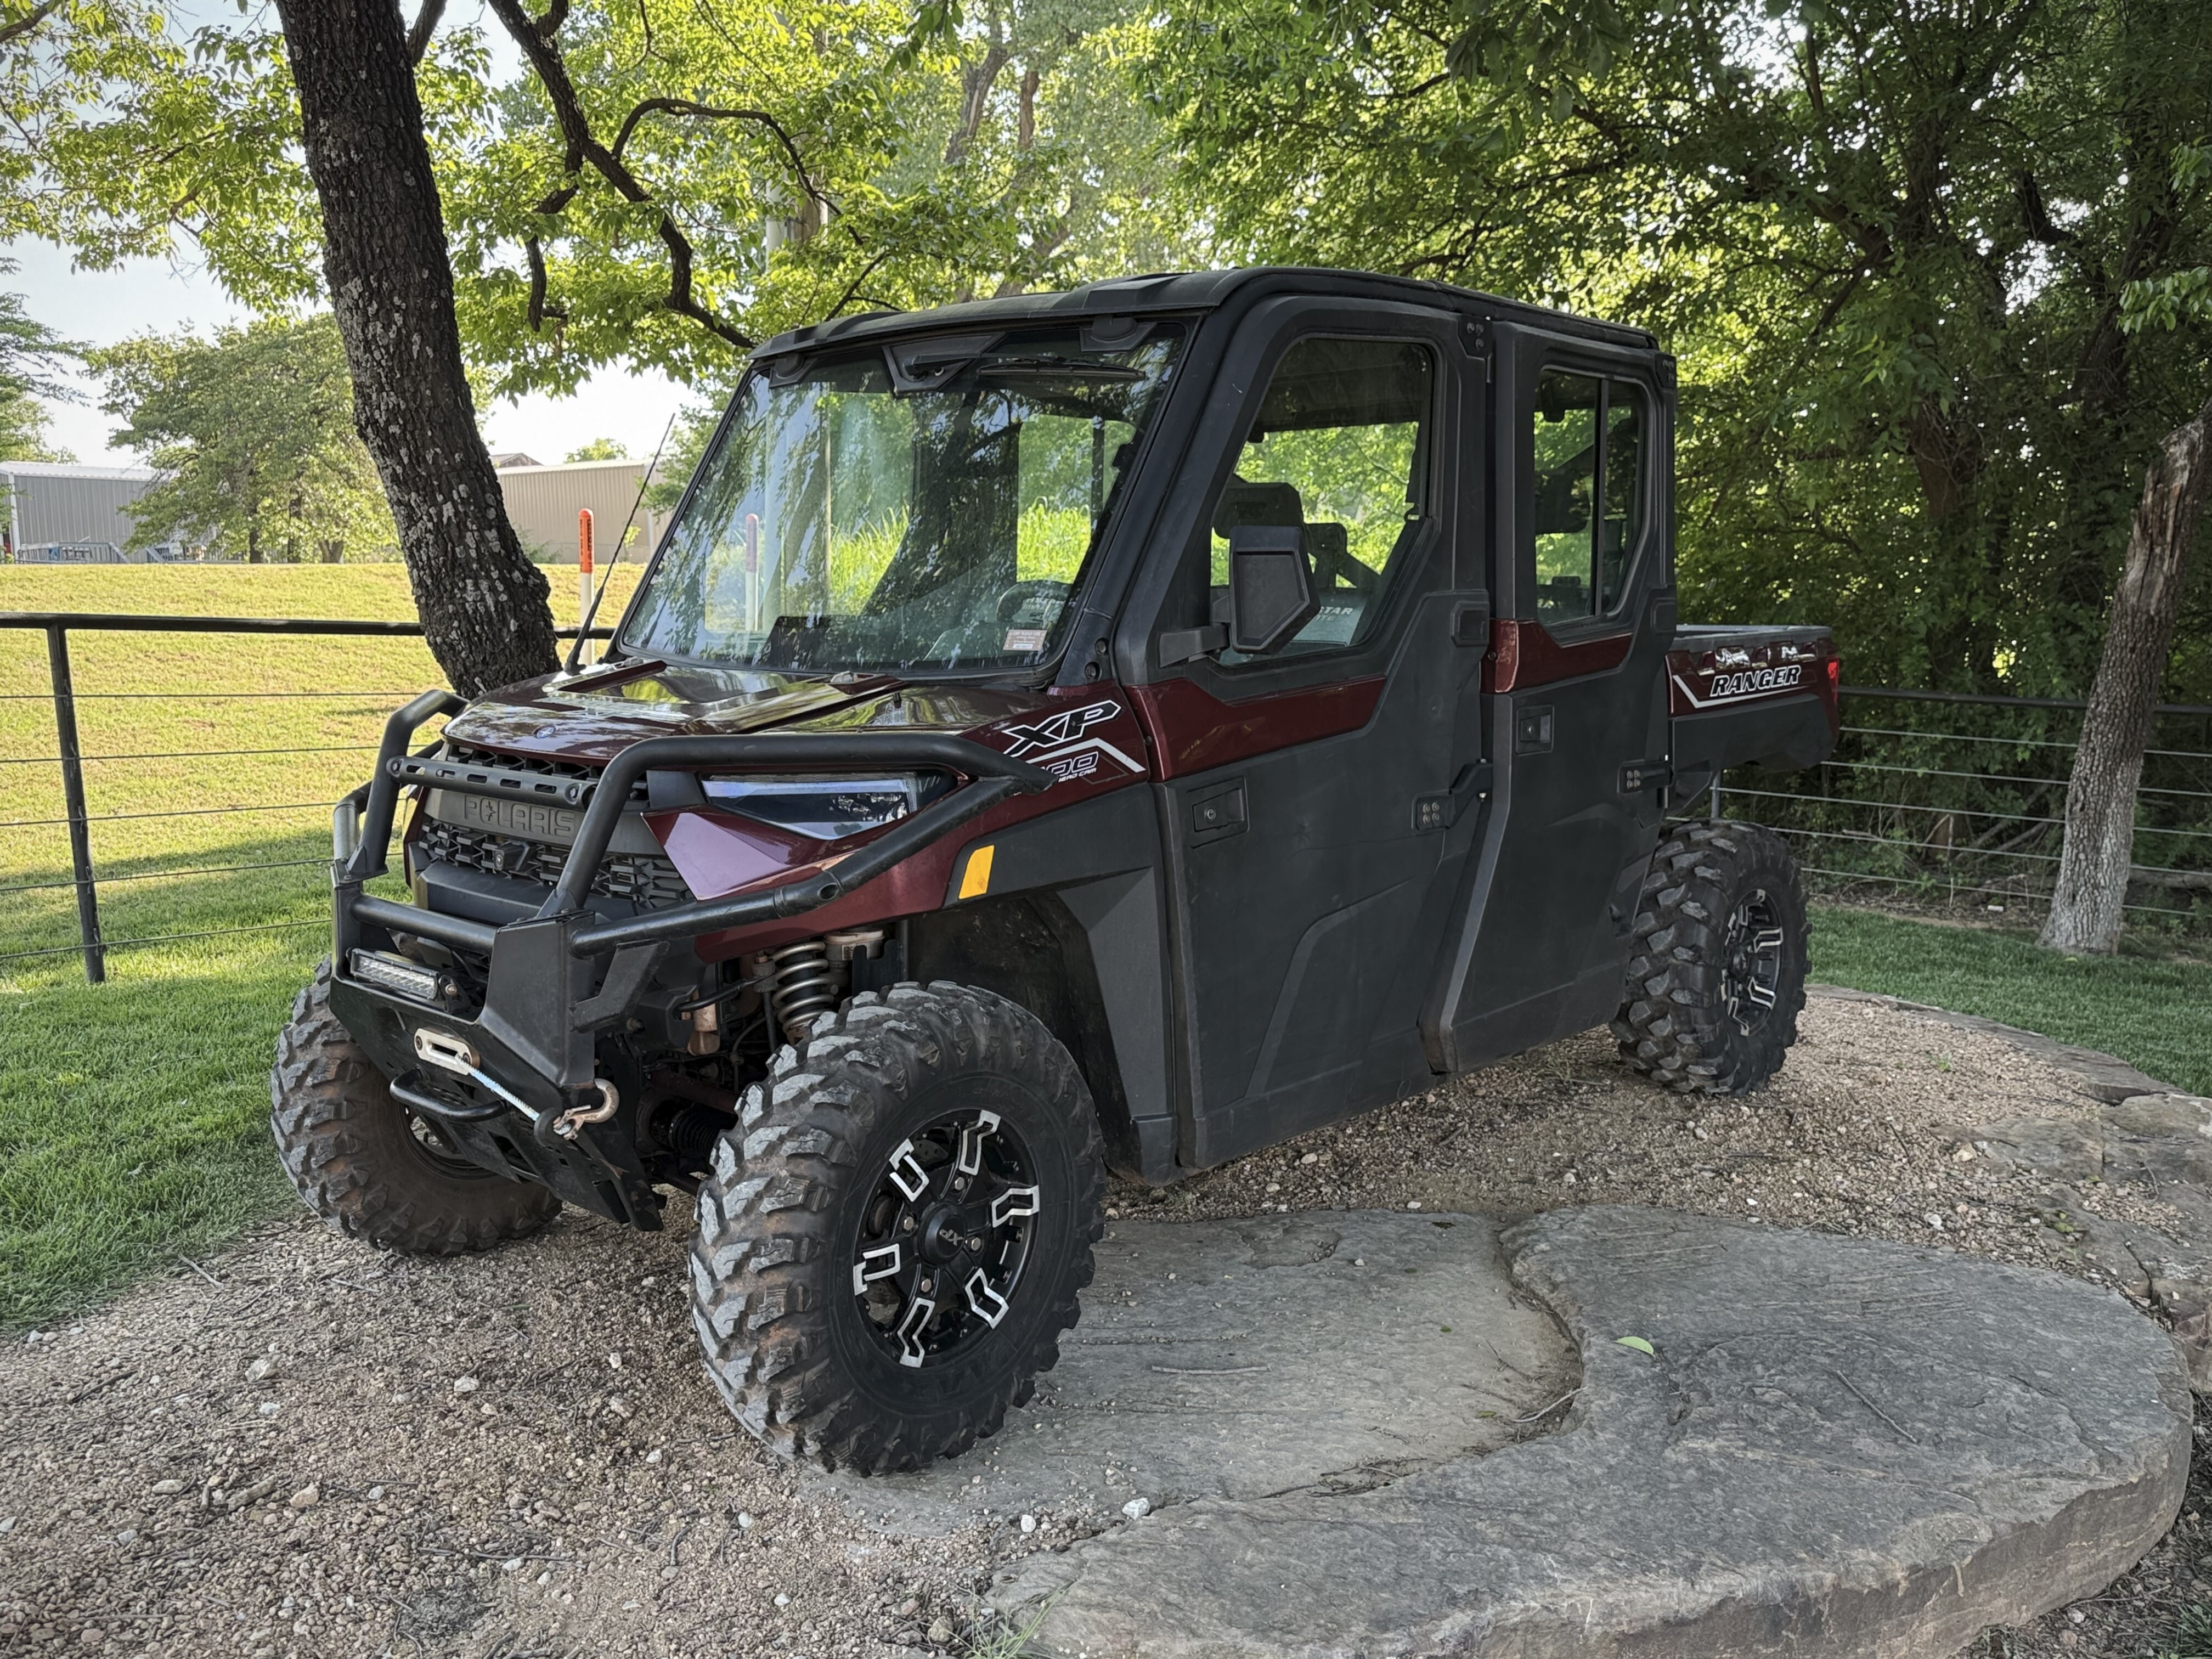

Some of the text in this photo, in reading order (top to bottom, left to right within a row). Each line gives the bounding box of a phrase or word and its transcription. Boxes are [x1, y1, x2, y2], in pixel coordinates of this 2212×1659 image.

[1709, 664, 1802, 697] RANGER
[1001, 699, 1122, 758] XP
[1079, 767, 1097, 777] CAM
[464, 794, 575, 838] POLARIS
